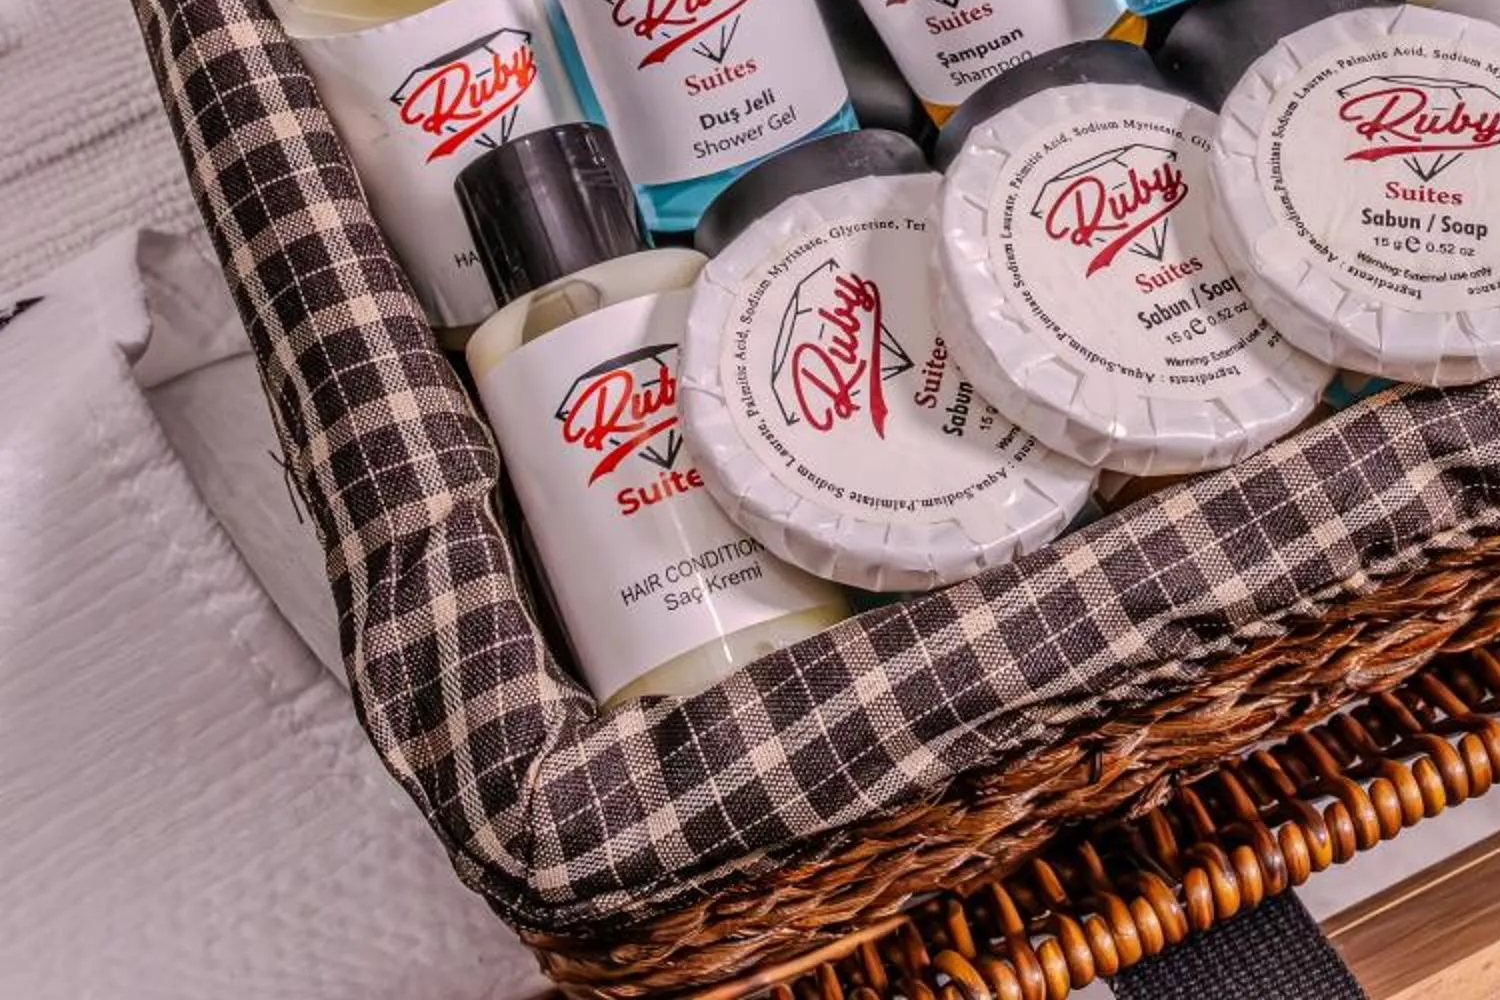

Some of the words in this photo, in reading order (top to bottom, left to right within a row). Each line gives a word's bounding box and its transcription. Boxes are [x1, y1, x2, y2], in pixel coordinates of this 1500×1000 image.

[925, 2, 994, 35] Suites
[937, 28, 1024, 68] Şampuan
[950, 50, 1033, 87] Shampoo
[684, 58, 757, 96] Suites
[1271, 100, 1298, 138] Sodium
[1433, 49, 1480, 67] Sodium
[400, 46, 536, 164] Ruby
[699, 108, 740, 131] Duş
[744, 88, 777, 116] Jeli
[693, 123, 764, 159] Shower
[768, 105, 797, 131] Gel
[1004, 243, 1024, 288] Sodium
[1072, 121, 1119, 136] Sodium
[1385, 182, 1463, 206] Suites
[1045, 163, 1188, 279] Ruby
[1361, 207, 1421, 230] Sabun
[1426, 213, 1437, 233] /
[1441, 215, 1488, 240] Soap
[1425, 241, 1456, 255] 0.52
[1135, 257, 1203, 294] Suites
[739, 279, 770, 324] Sodium
[1138, 300, 1192, 330] Sabun
[791, 272, 888, 440] Ruby
[1166, 331, 1182, 345] 15
[1183, 329, 1193, 341] g
[737, 365, 759, 417] Palmitic
[942, 381, 975, 437] Sabun
[563, 364, 678, 487] Rub
[980, 416, 993, 430] 15
[617, 468, 705, 516] Suite
[796, 464, 844, 498] Sodium
[620, 573, 663, 606] HAIR
[665, 536, 765, 583] CONDITION
[664, 587, 703, 611] Saç
[706, 560, 763, 594] Kremi
